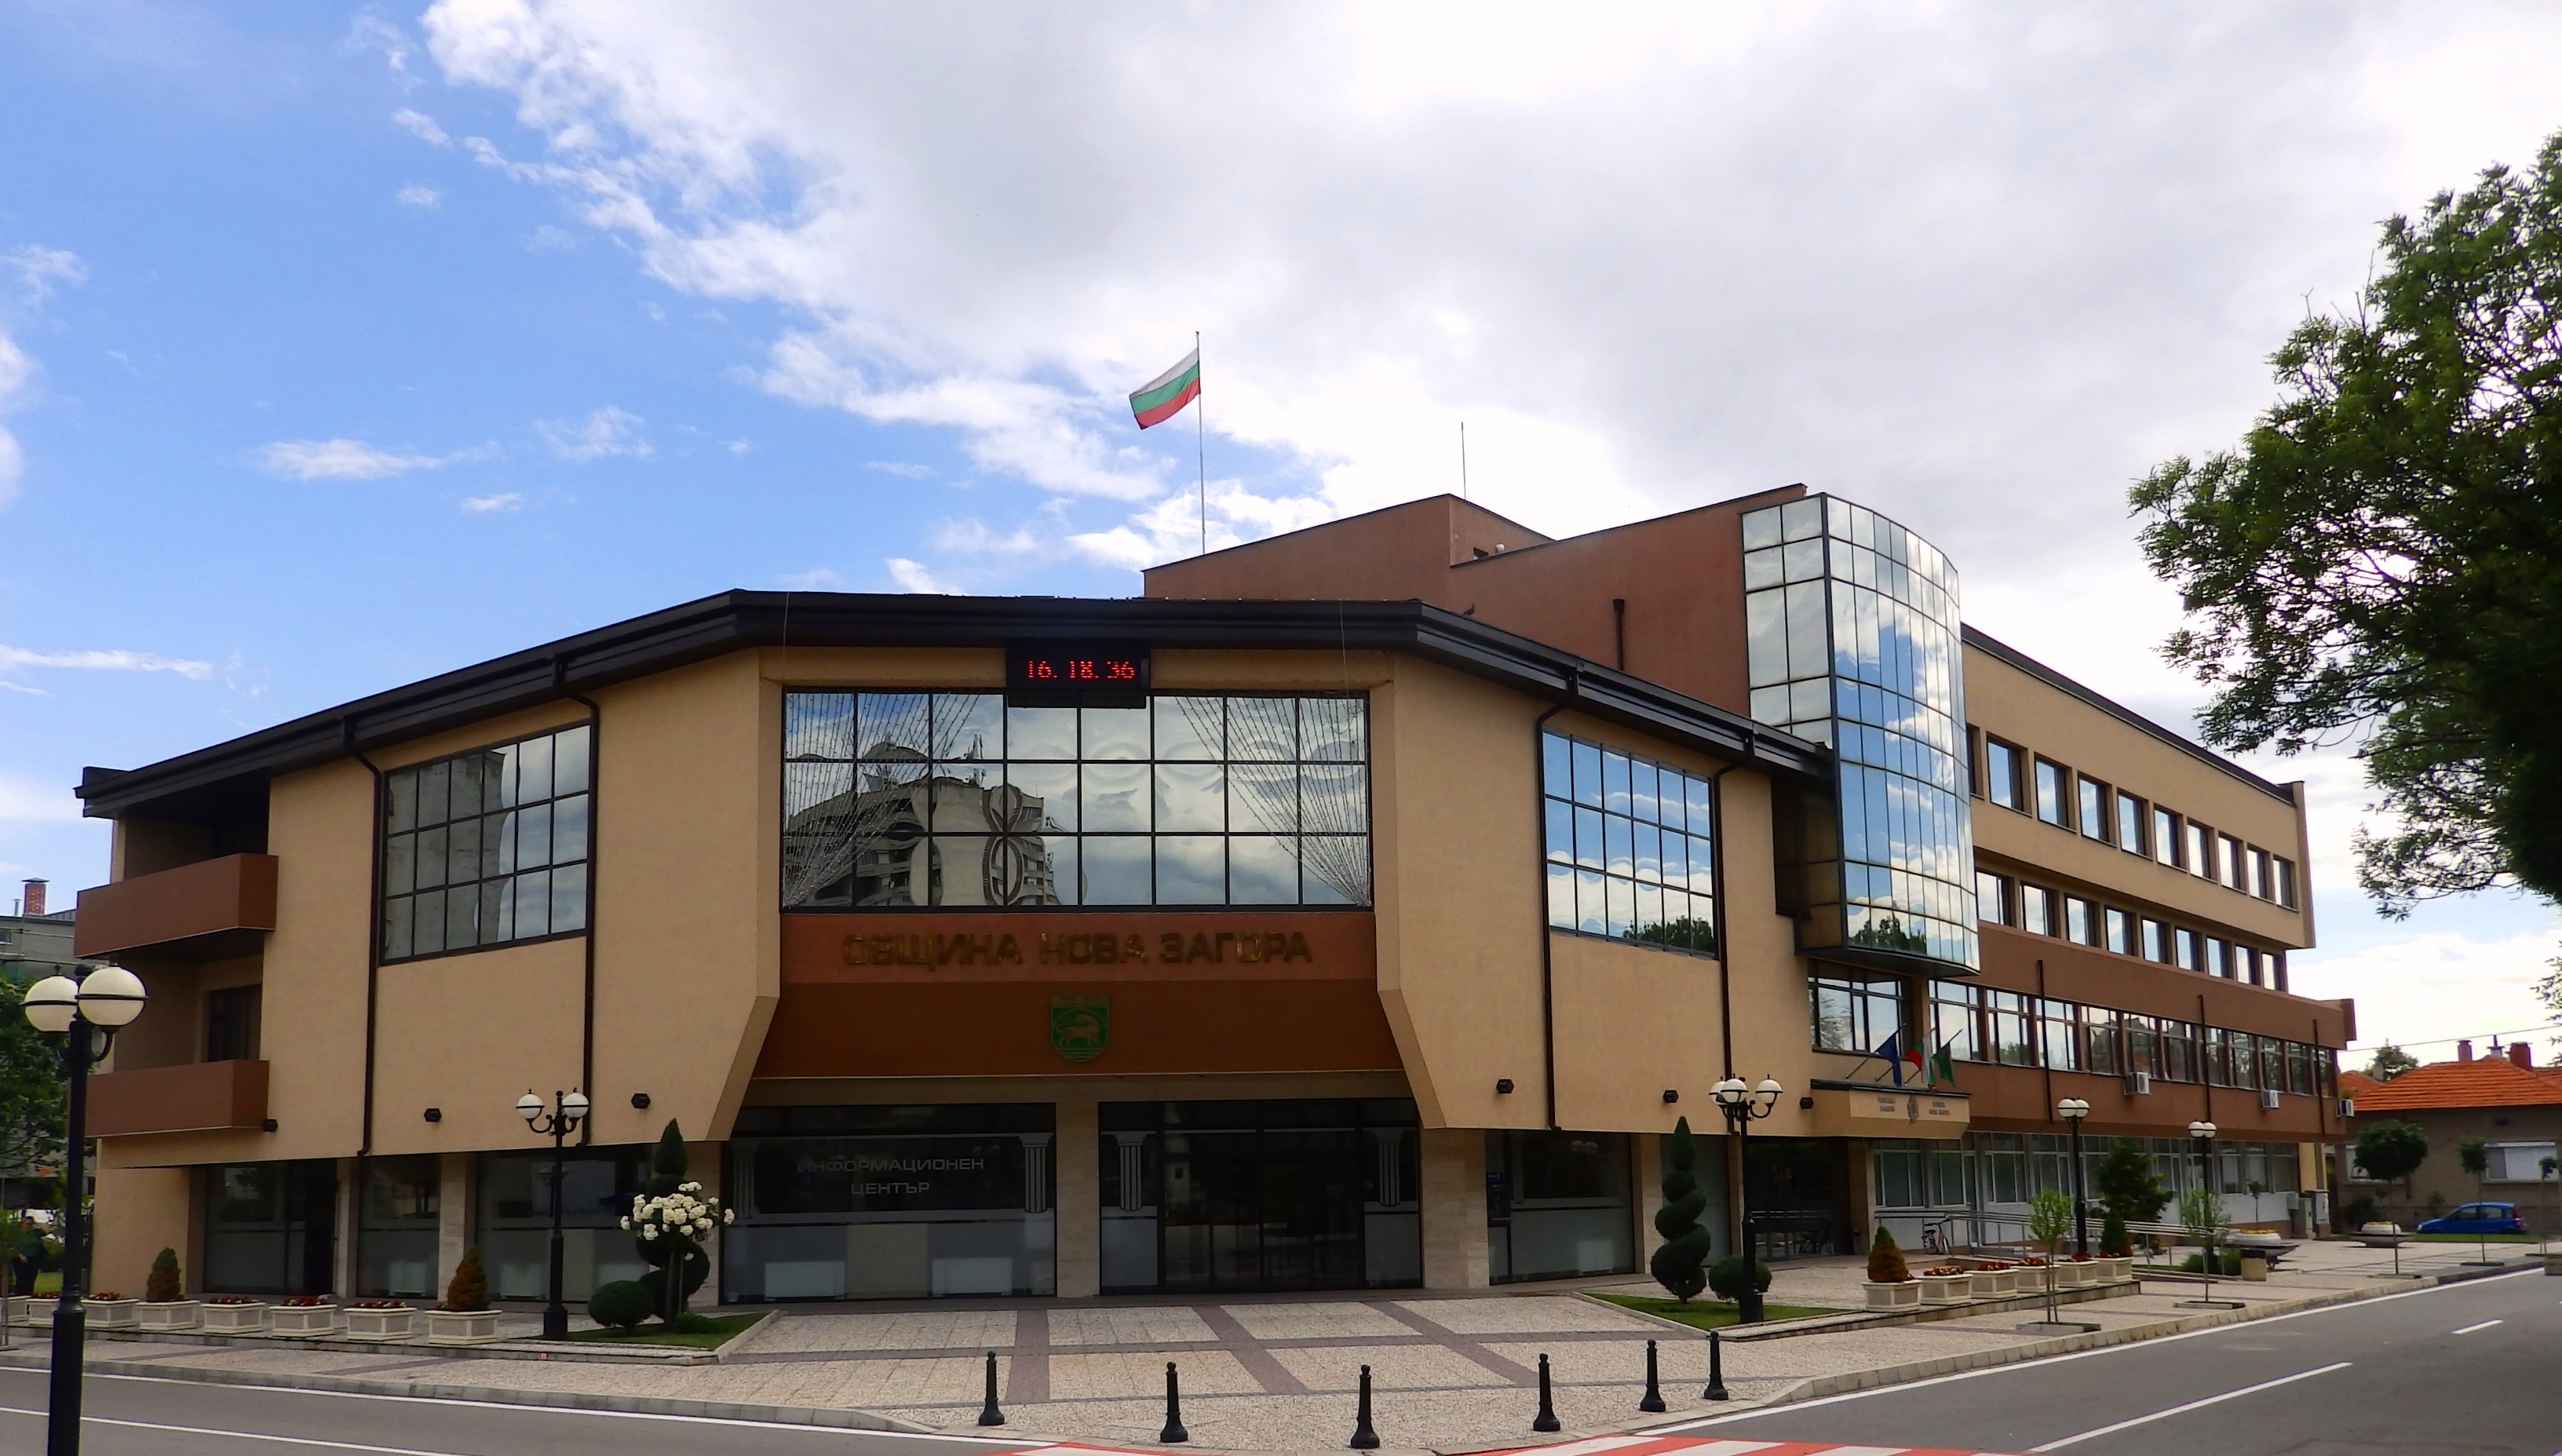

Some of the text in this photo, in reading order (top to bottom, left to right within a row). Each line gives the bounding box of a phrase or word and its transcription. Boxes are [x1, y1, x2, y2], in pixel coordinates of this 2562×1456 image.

[1027, 660, 1135, 678] 16. 18. 36
[844, 932, 1312, 972] ОБЩИНА НОВА ЗАГОРА
[797, 1159, 984, 1173] ИНФОРМАЦИОНЕН
[851, 1182, 930, 1195] ЦЕНТЪР
